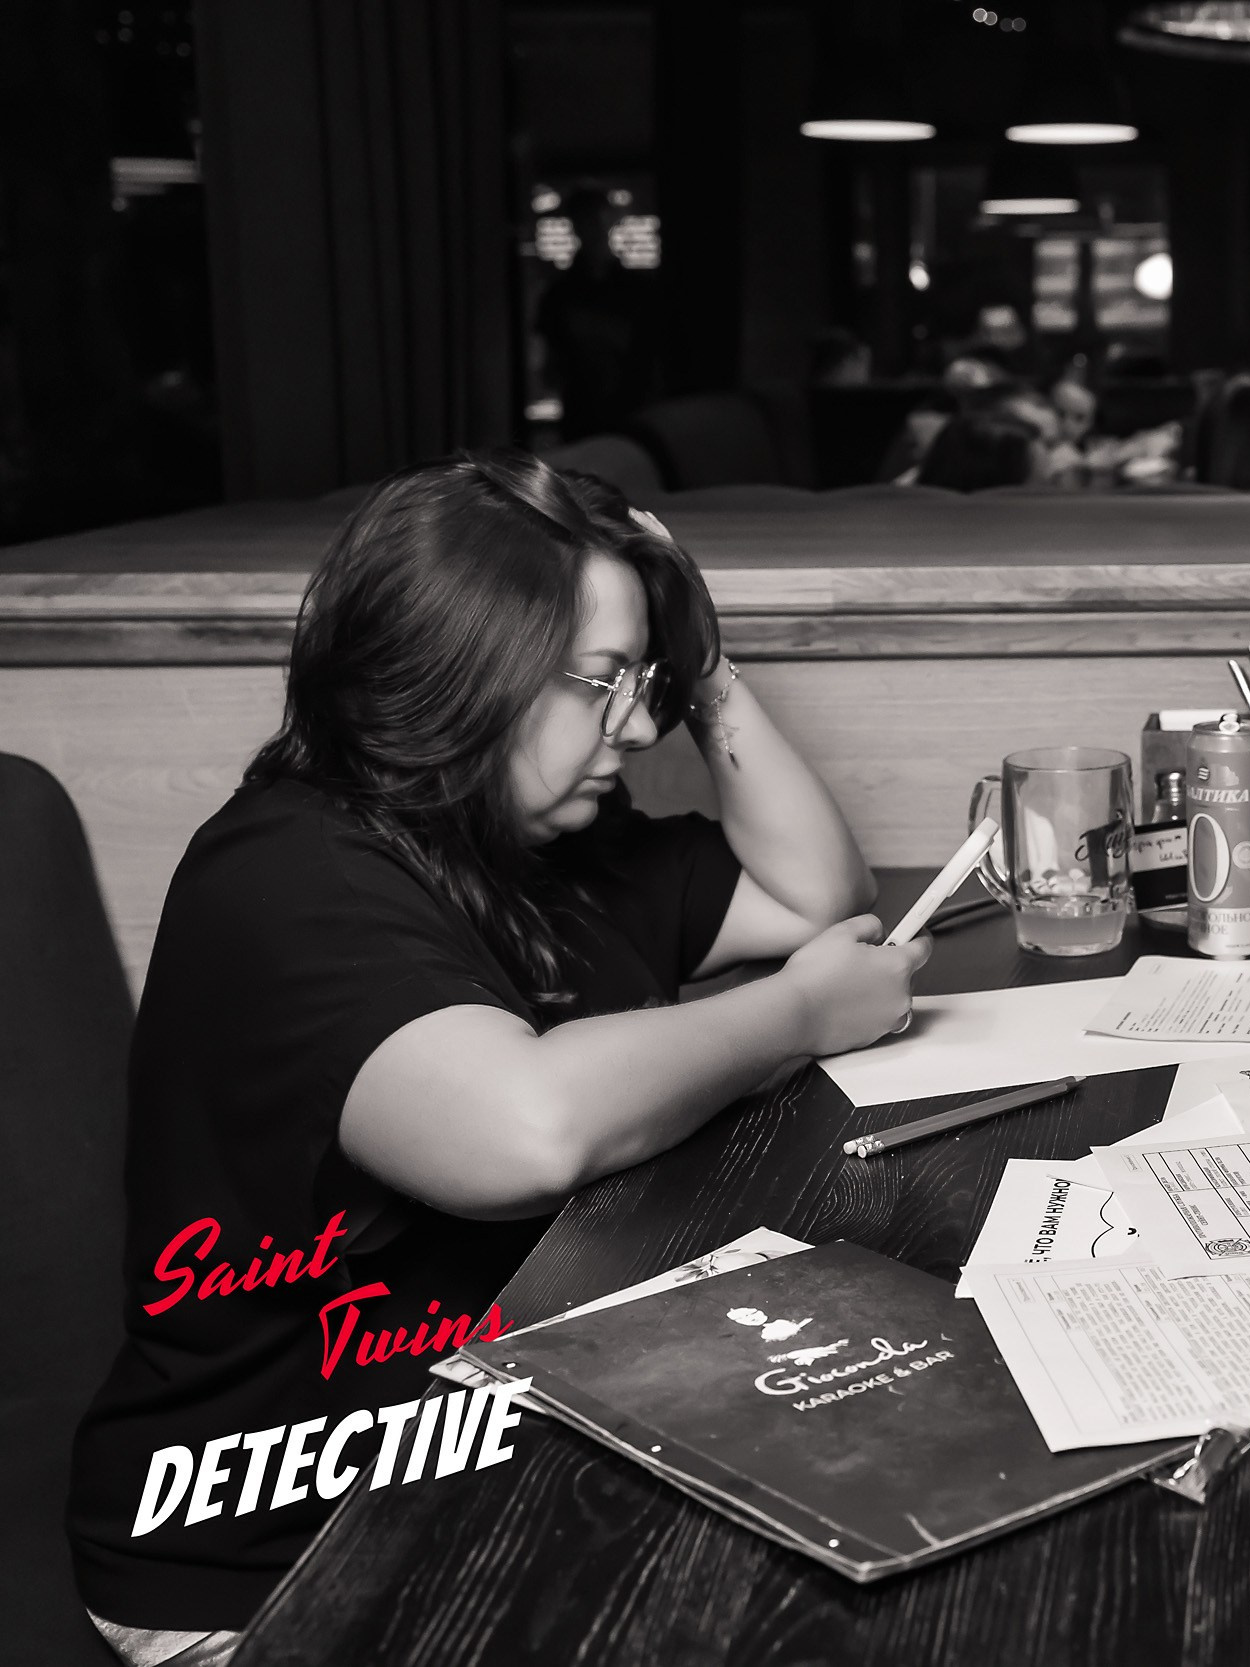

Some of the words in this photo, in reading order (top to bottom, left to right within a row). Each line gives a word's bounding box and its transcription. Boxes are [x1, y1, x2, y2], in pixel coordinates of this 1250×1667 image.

[1045, 1178, 1071, 1214] НУЖНО
[1038, 1215, 1062, 1236] ВАМ
[1031, 1237, 1054, 1255] ЧТО
[753, 1336, 929, 1397] Gioconda
[792, 1372, 896, 1413] KARAOKE
[893, 1365, 912, 1379] &
[909, 1349, 956, 1372] BAR
